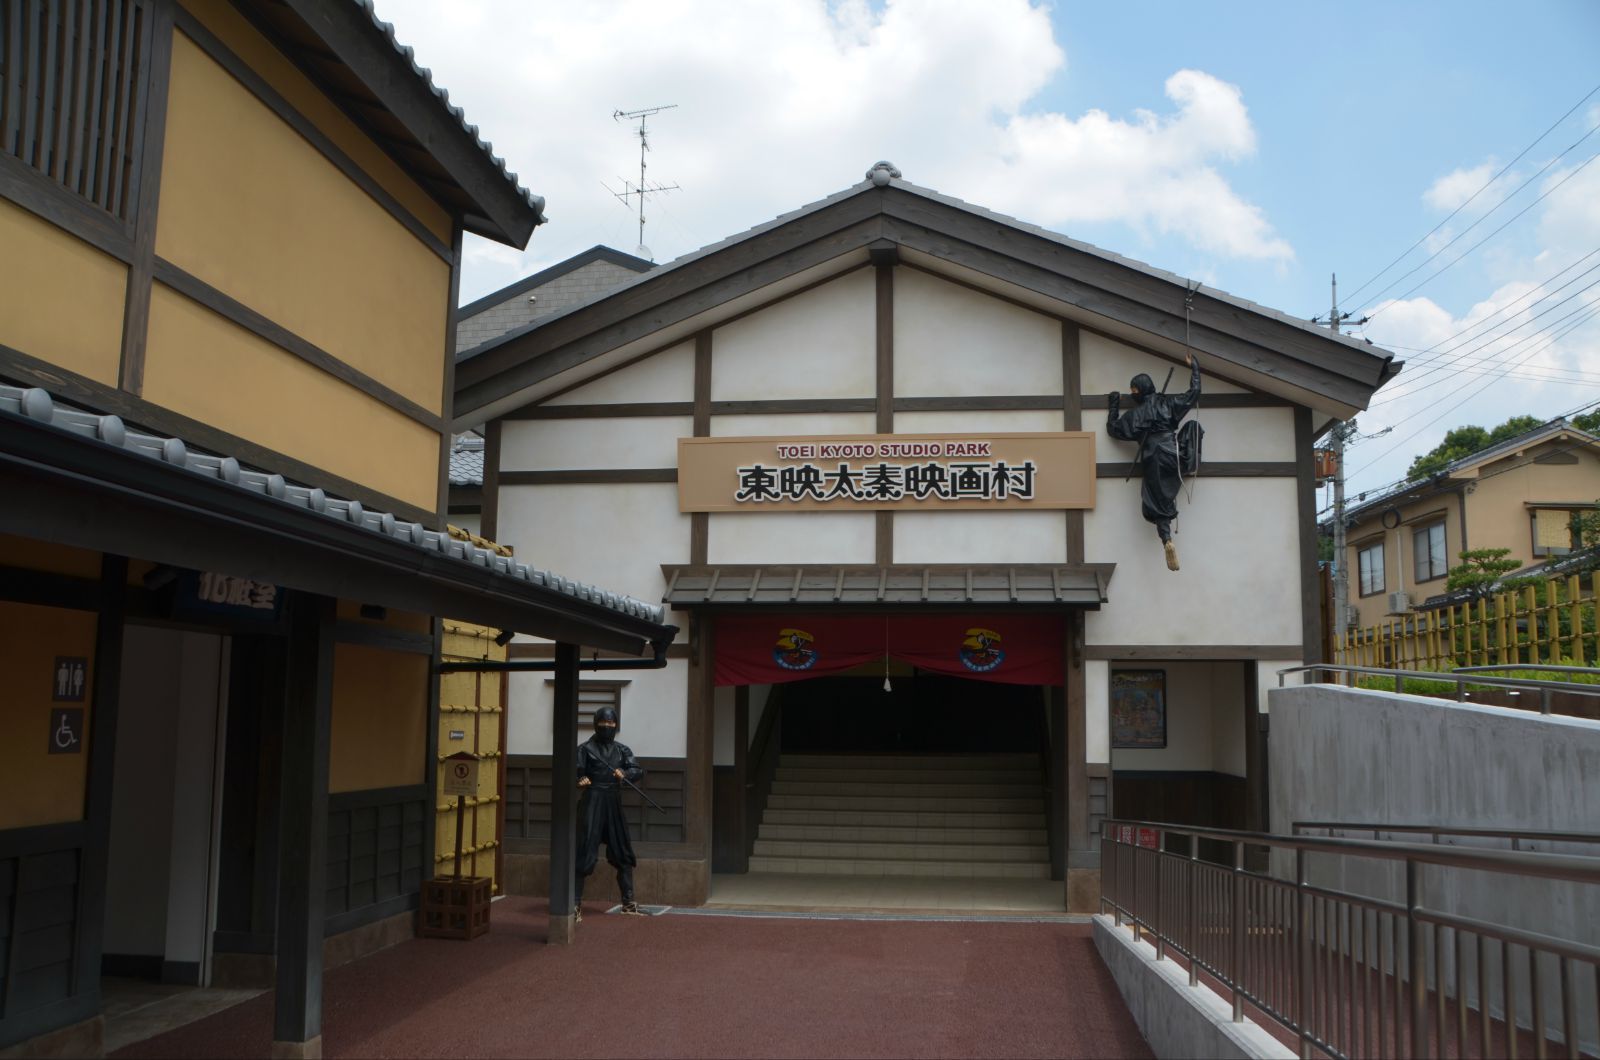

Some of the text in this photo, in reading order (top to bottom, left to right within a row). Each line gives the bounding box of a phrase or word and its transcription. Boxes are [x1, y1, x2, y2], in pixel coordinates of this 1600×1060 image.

[777, 442, 990, 458] TOEI KYOTO STUDIO PARK
[735, 462, 1036, 501] 東映太秦映画村
